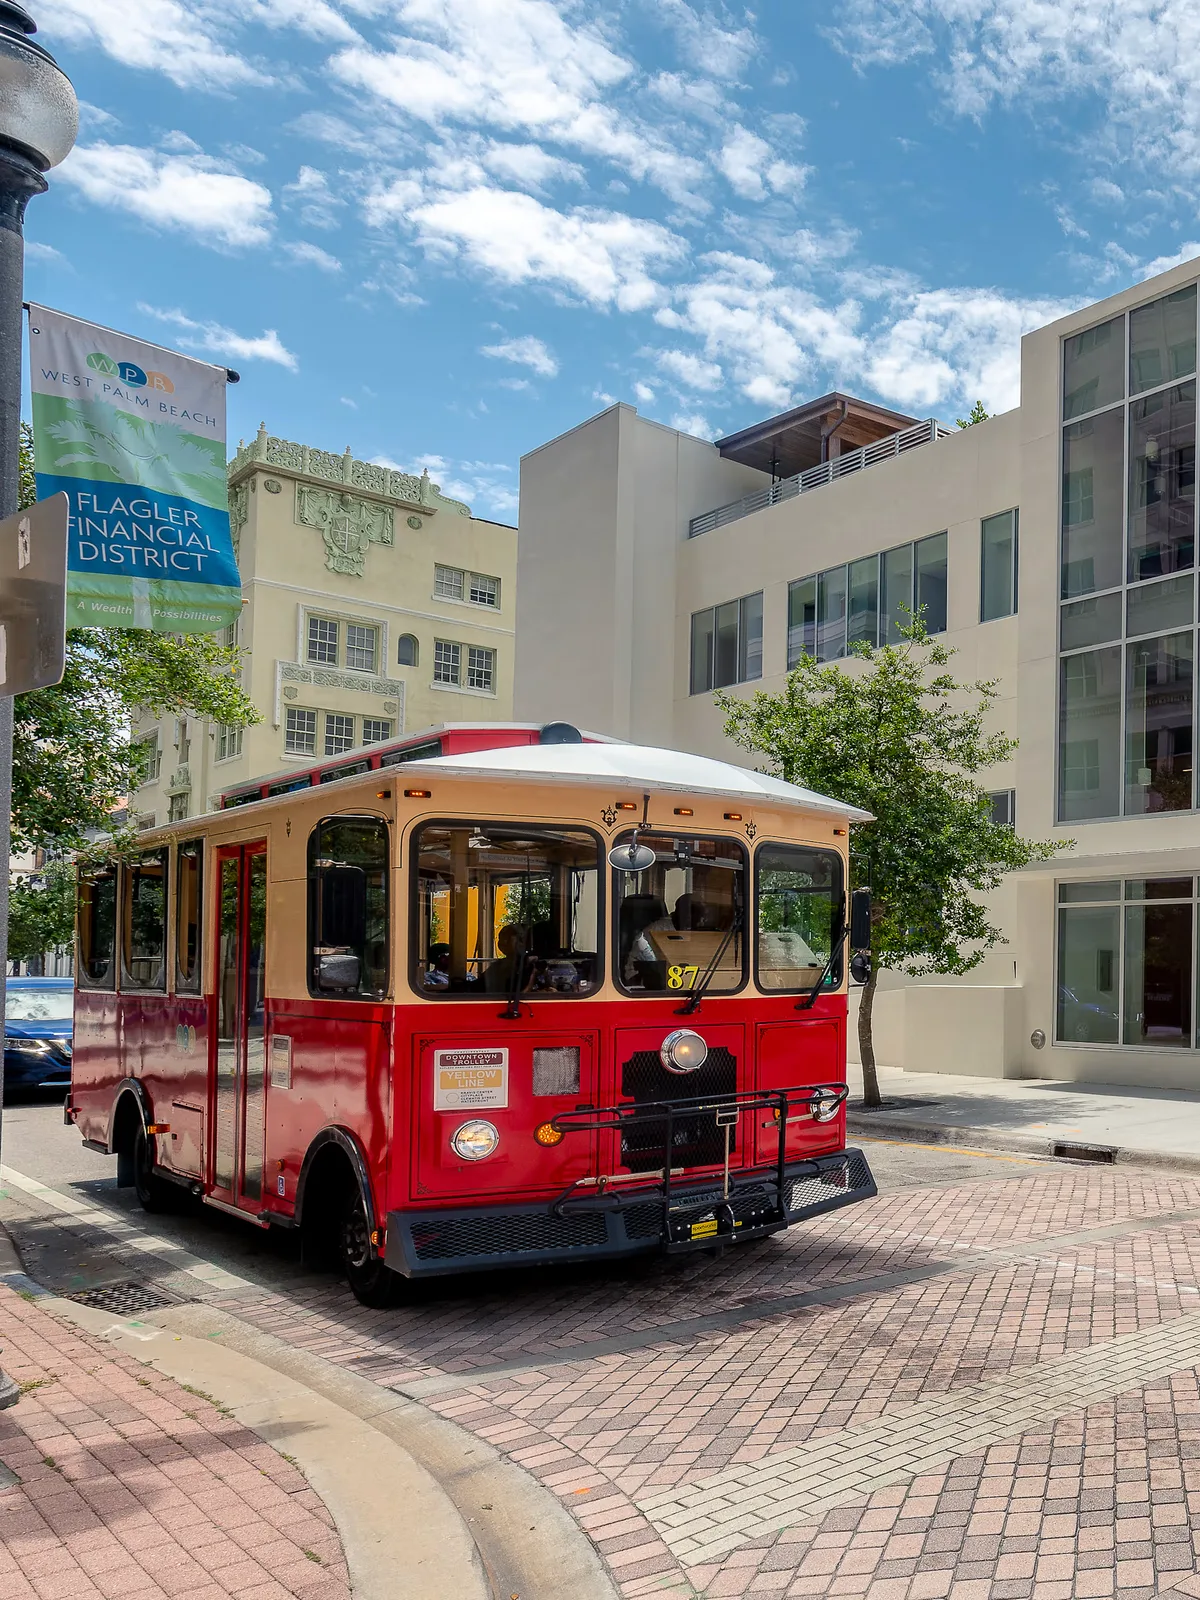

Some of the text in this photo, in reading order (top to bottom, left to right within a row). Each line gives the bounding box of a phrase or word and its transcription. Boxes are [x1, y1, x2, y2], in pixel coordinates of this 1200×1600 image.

[41, 368, 217, 428] WEST PALM BEACH
[77, 492, 202, 529] FLAGLER
[68, 516, 221, 554] FINANCIAL
[78, 541, 209, 572] DISTRICT
[76, 601, 86, 610] A
[91, 602, 133, 615] Wealth
[153, 609, 222, 622] Possibilities
[667, 965, 700, 990] 87
[446, 1053, 497, 1061] DOWNTOWN
[447, 1070, 496, 1080] YELLOW
[458, 1079, 485, 1088] LINE
